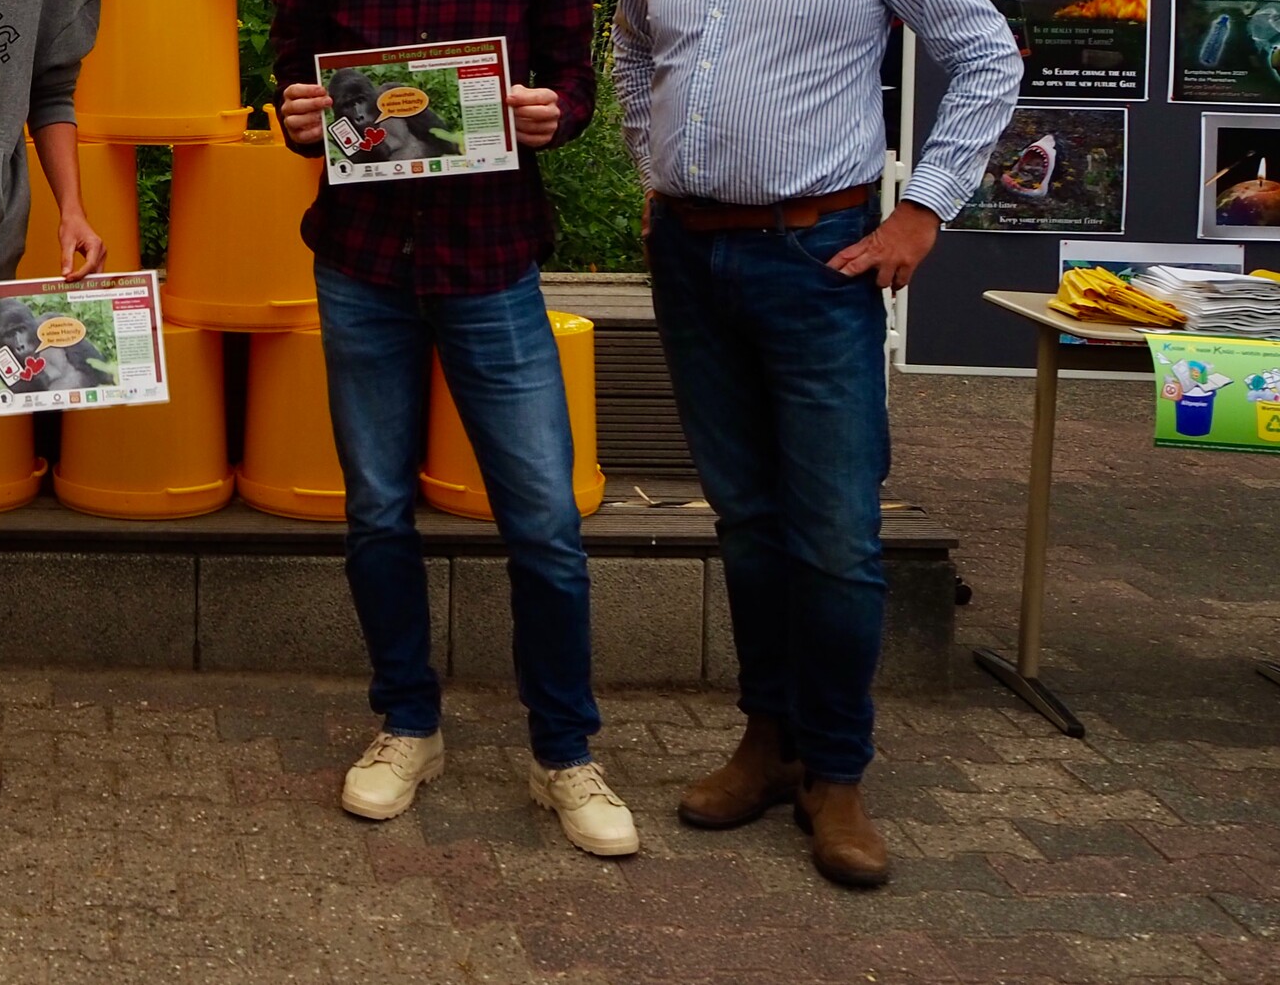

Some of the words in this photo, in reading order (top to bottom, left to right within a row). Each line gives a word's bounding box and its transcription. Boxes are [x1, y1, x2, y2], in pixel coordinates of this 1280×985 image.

[382, 53, 396, 61] Ein
[398, 50, 426, 60] Handy
[429, 48, 442, 57] für
[445, 46, 462, 55] den
[464, 43, 495, 53] Gorilla
[999, 215, 1018, 225] Keep
[42, 283, 56, 291] Ein
[58, 281, 84, 291] Handy
[86, 280, 98, 288] für
[101, 279, 116, 287] den
[118, 277, 146, 286] Gorilla
